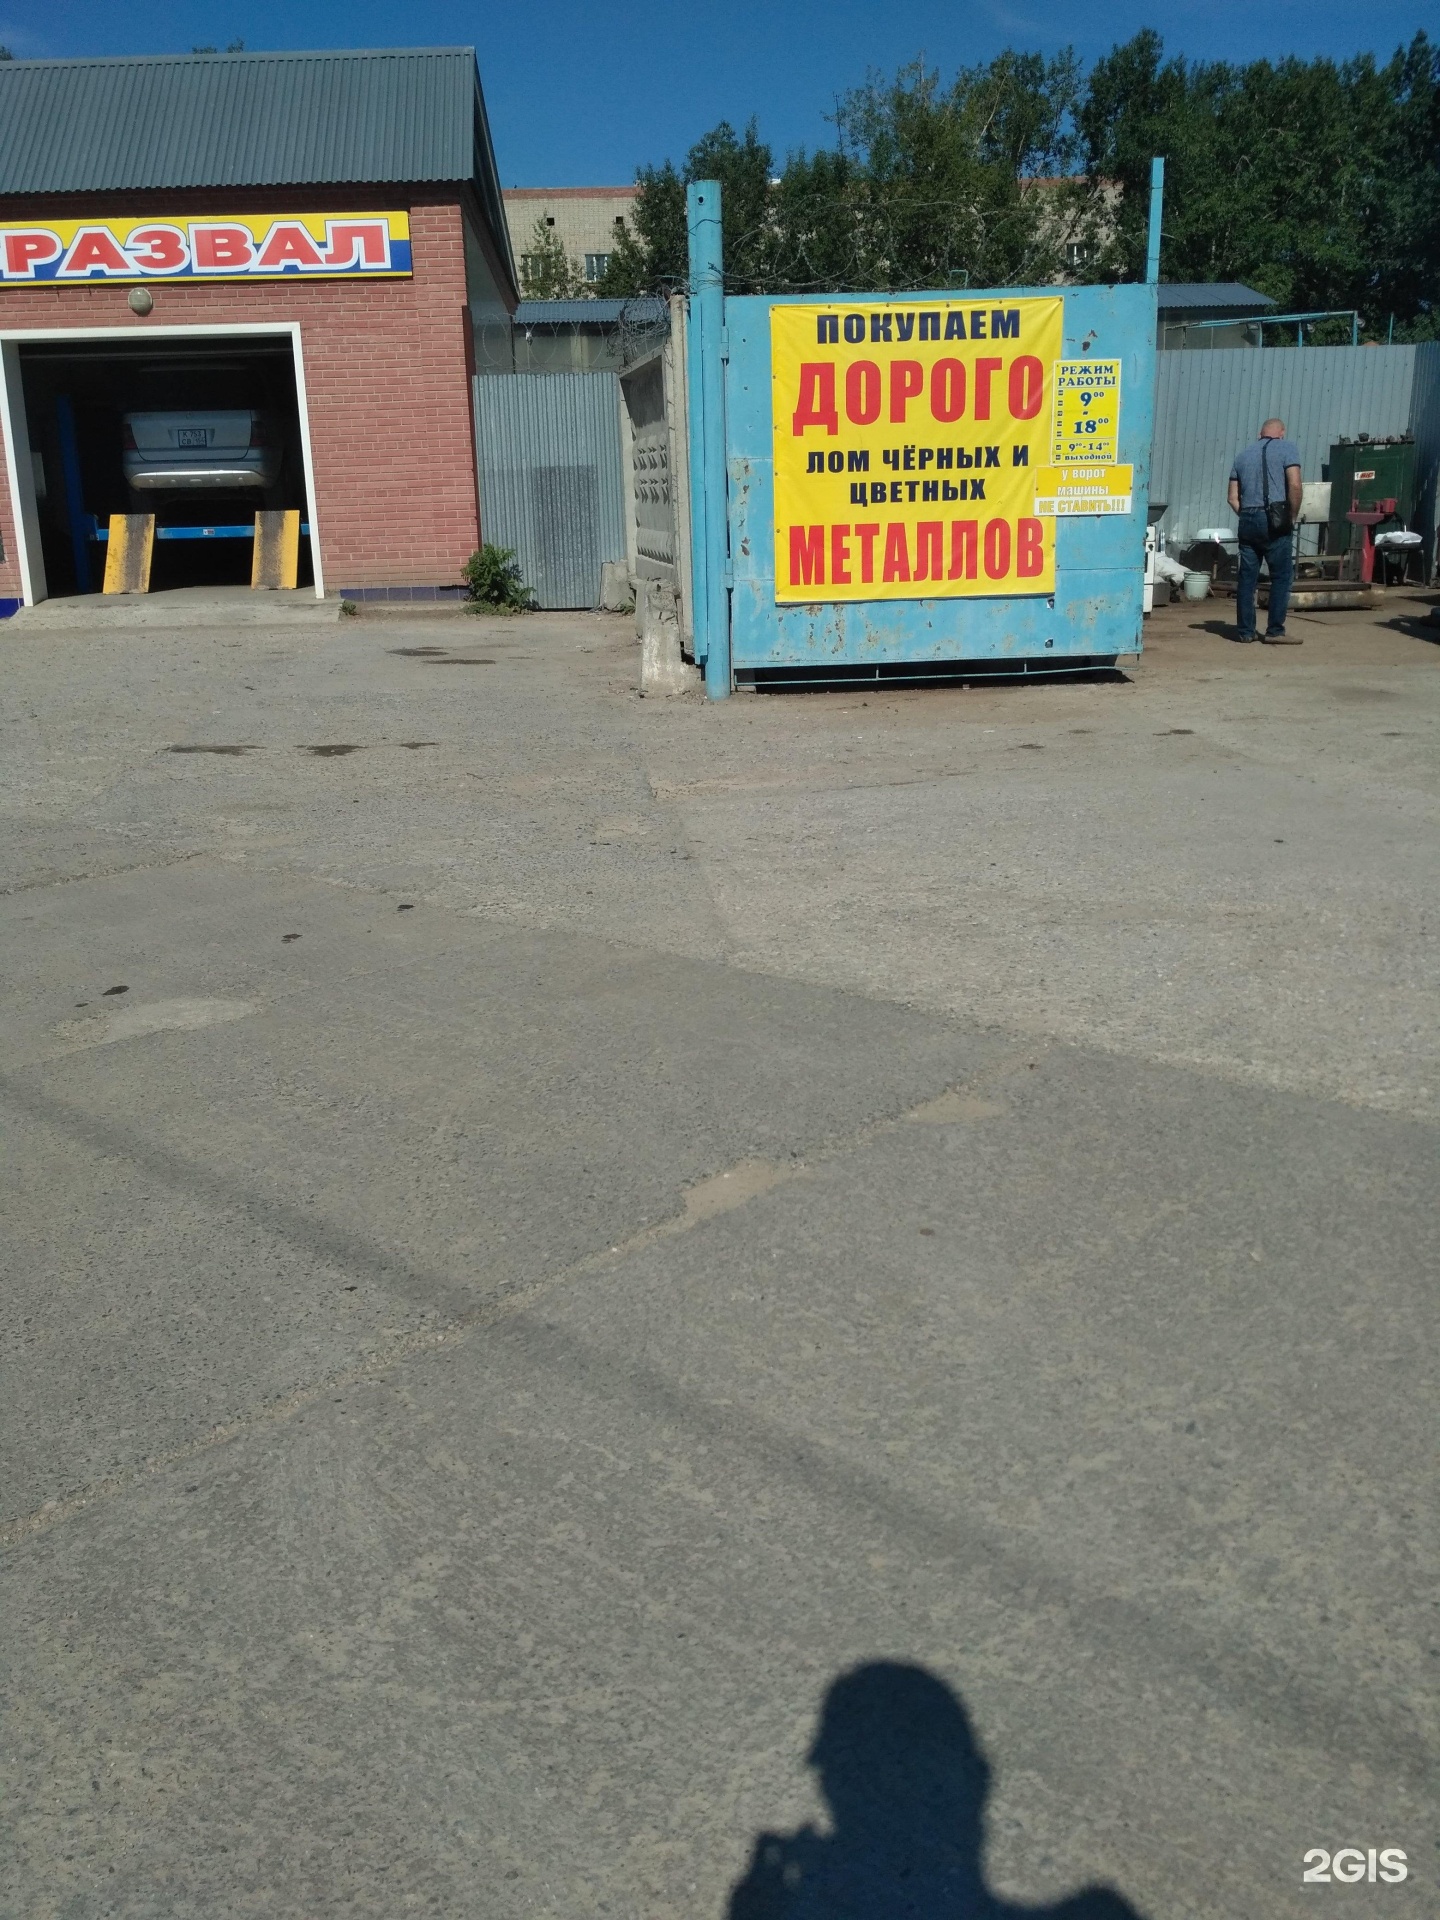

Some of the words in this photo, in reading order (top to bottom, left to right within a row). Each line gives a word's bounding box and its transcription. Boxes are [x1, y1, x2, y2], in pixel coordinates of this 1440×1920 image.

[4, 220, 390, 277] РАЗВАЛ
[817, 309, 1020, 344] ПОКУПАЕМ
[1061, 365, 1113, 375] РЕЖИМ
[1058, 376, 1116, 386] РАБОТЫ
[792, 354, 1043, 436] ДОРОГО
[806, 450, 869, 473] ЛОМ
[882, 445, 1001, 471] ЧЁРНЫХ
[1012, 445, 1029, 467] И
[1064, 453, 1112, 461] выходной
[1062, 469, 1069, 481] у
[1072, 468, 1106, 480] ворот
[850, 479, 985, 507] ЦВЕТНЫХ
[1057, 485, 1109, 496] машины
[1039, 501, 1054, 513] НЕ
[1058, 499, 1125, 513] СТАВИТЬ!!!
[789, 517, 1044, 586] МЕТАЛЛОВ
